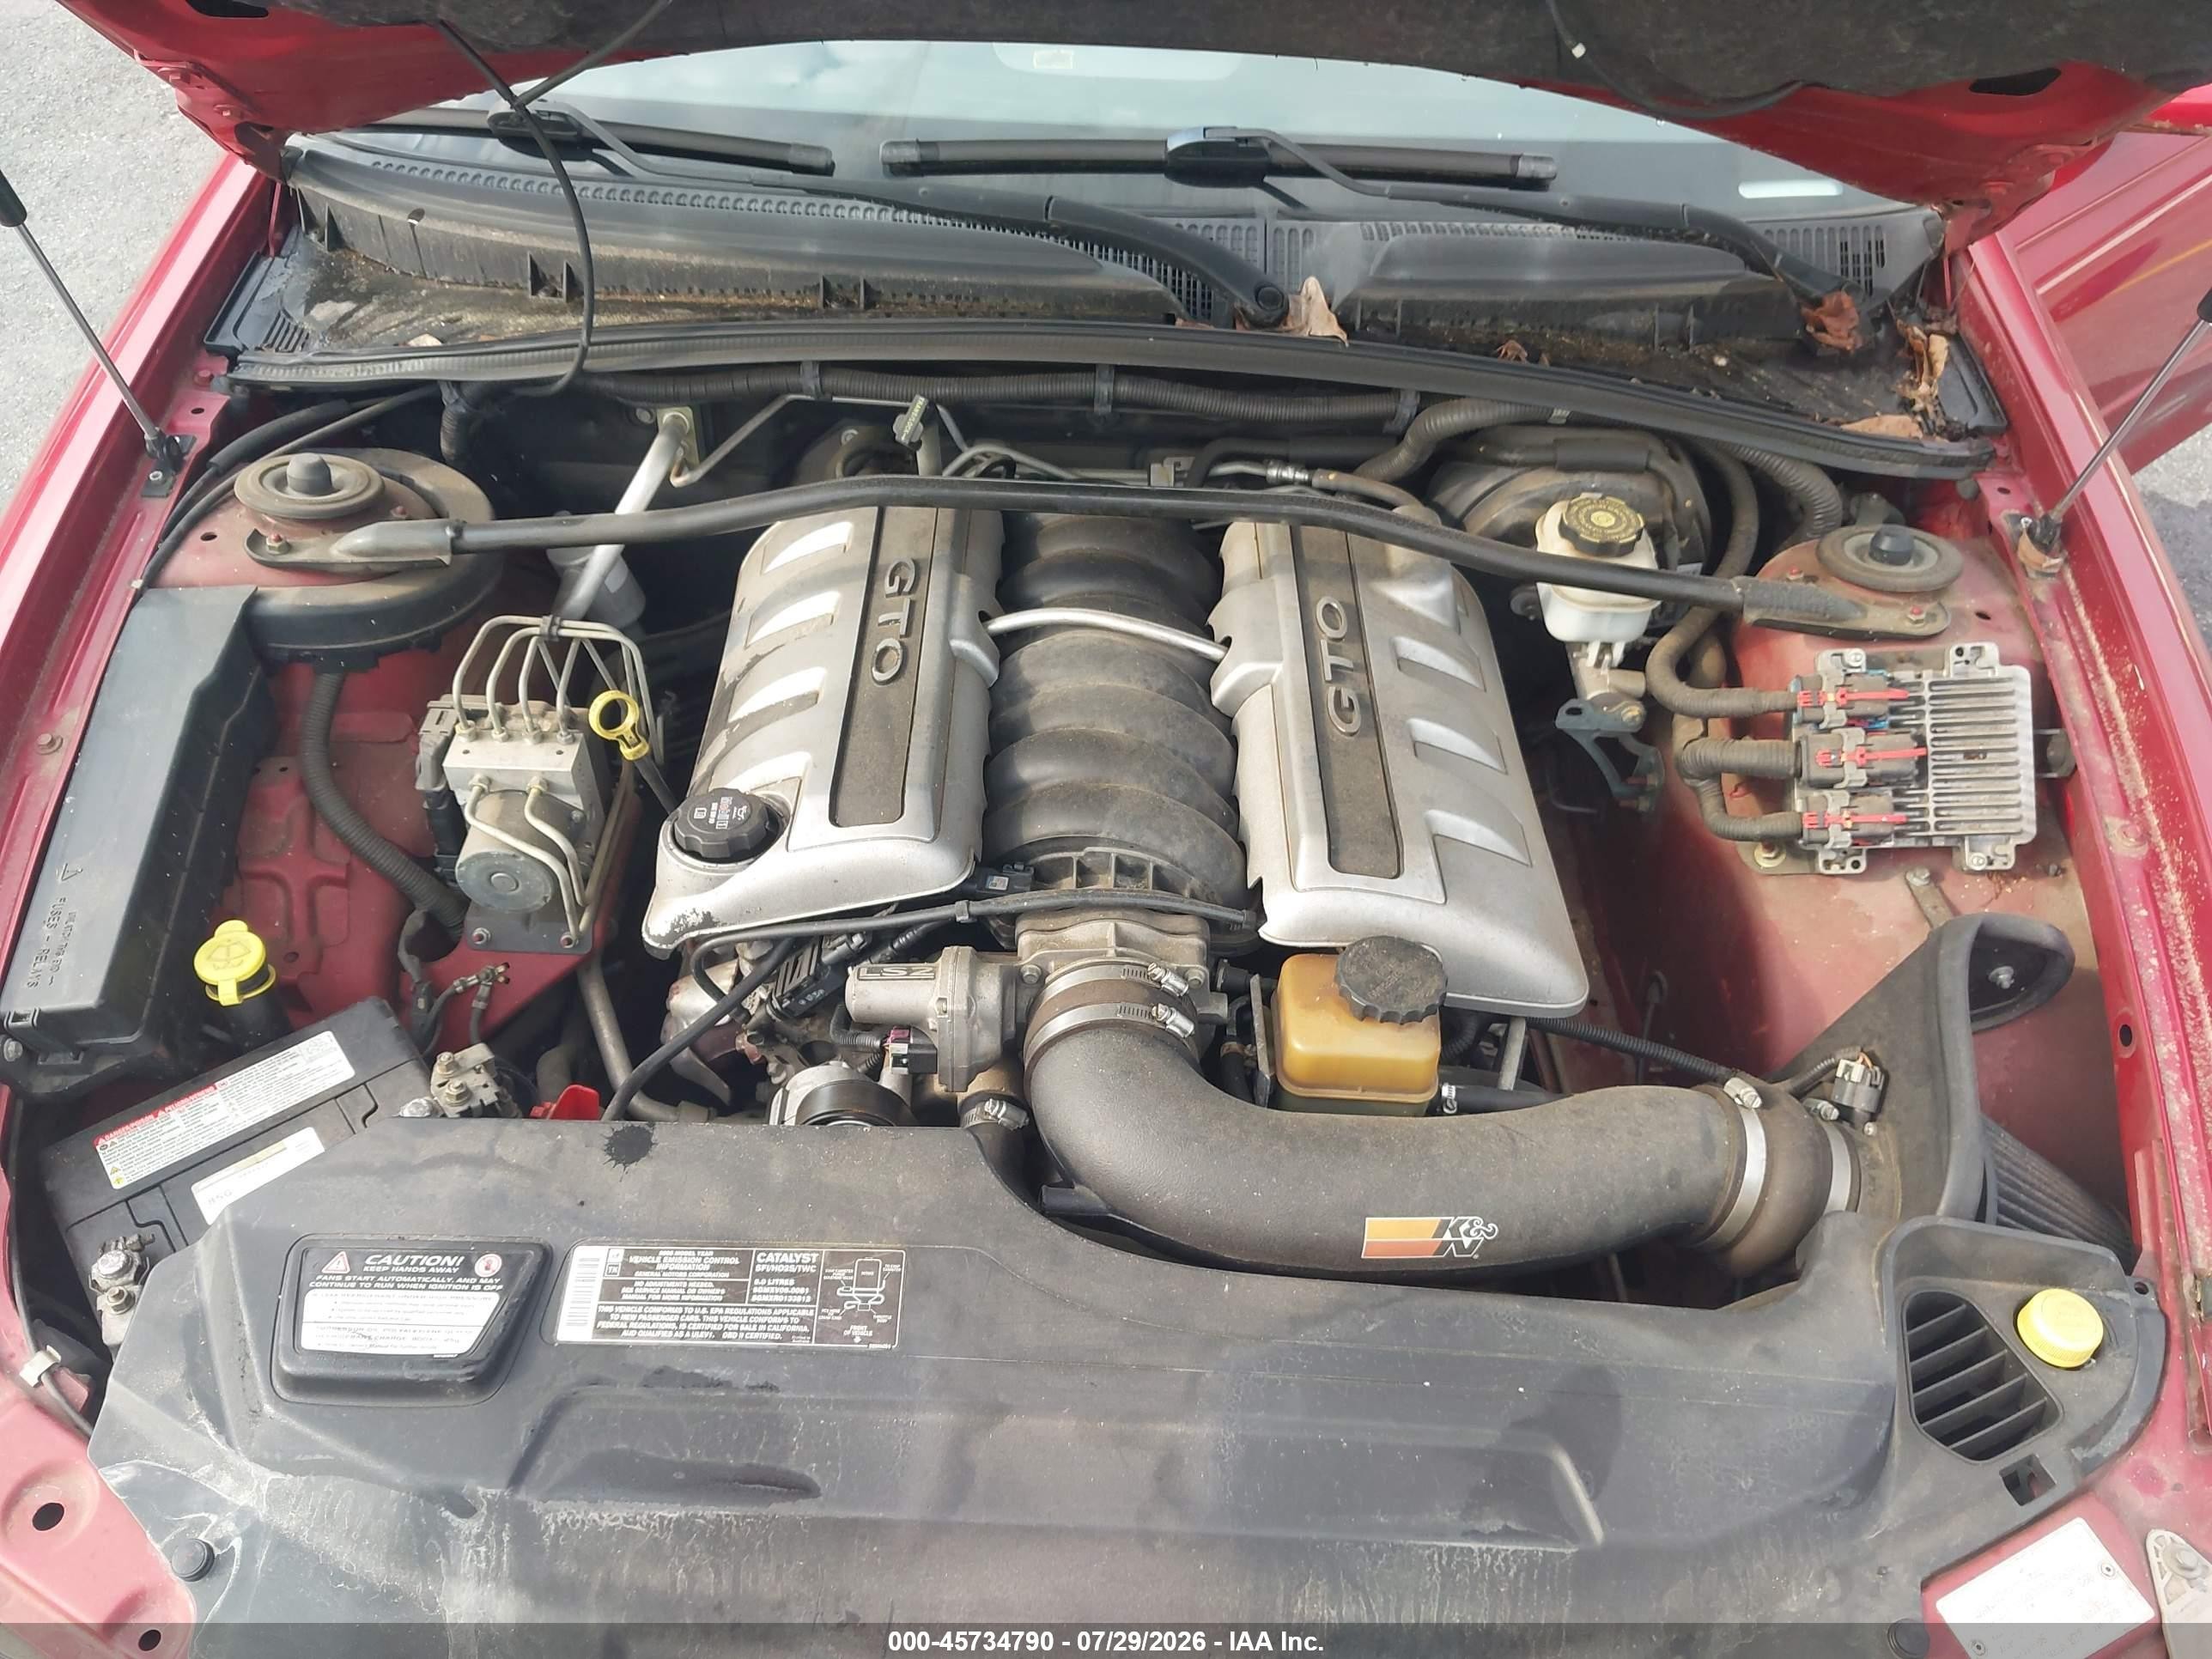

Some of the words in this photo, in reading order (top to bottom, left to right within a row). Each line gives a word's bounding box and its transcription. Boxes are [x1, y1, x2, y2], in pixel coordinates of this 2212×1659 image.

[872, 558, 915, 684] GTO
[1316, 596, 1361, 736] GTO
[860, 967, 935, 976] LS2
[365, 1255, 464, 1267] CAUTION!
[757, 1253, 819, 1264] CATALYST
